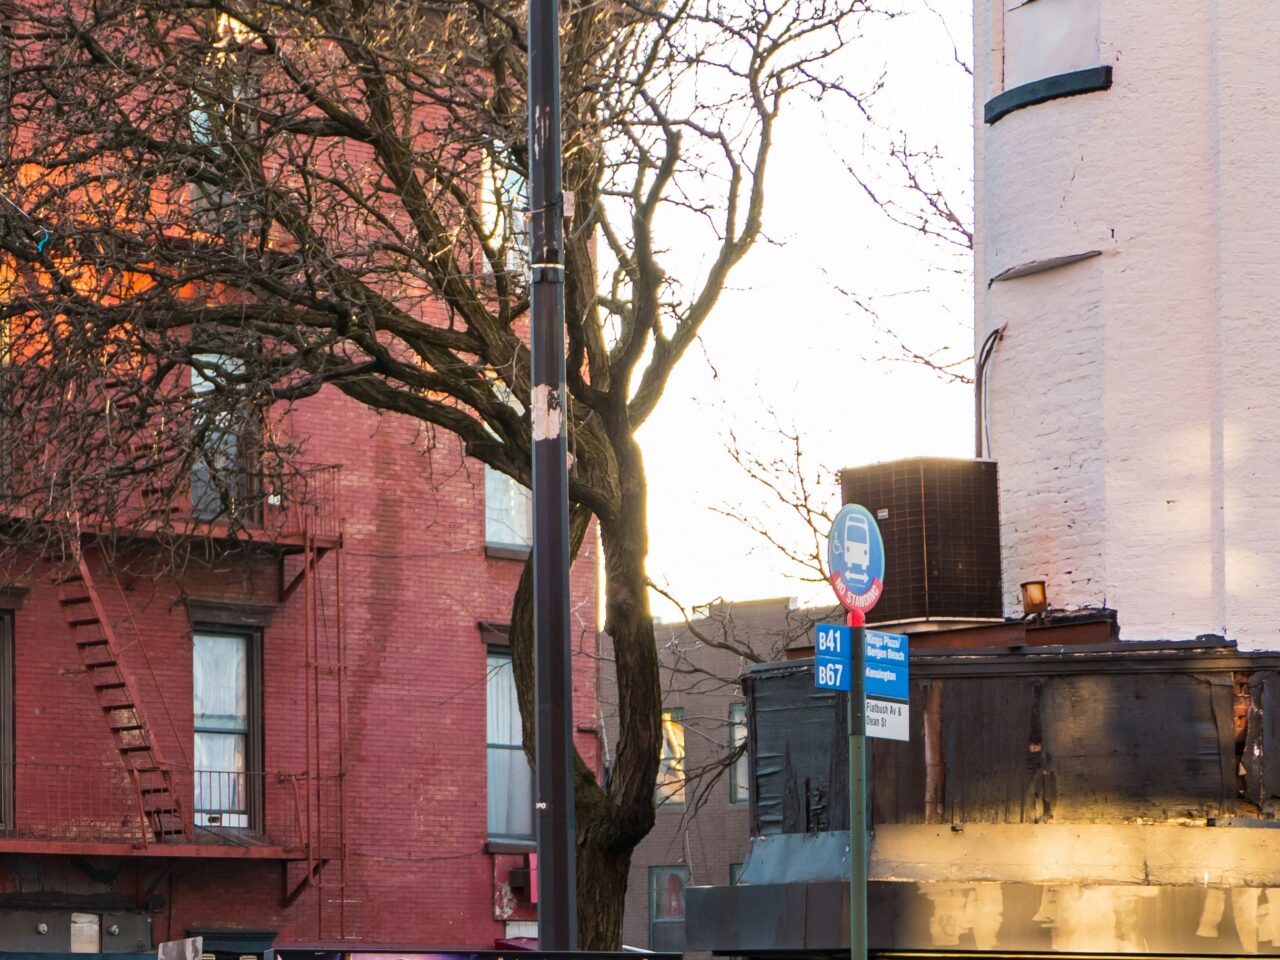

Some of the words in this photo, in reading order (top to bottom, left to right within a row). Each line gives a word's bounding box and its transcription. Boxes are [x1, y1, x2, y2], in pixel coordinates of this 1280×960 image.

[835, 576, 847, 596] NO
[846, 585, 880, 608] STANDING
[818, 628, 841, 653] B41
[818, 662, 843, 687] B67
[866, 702, 889, 715] Flatbush
[890, 705, 897, 715] Av
[866, 715, 880, 727] Dean
